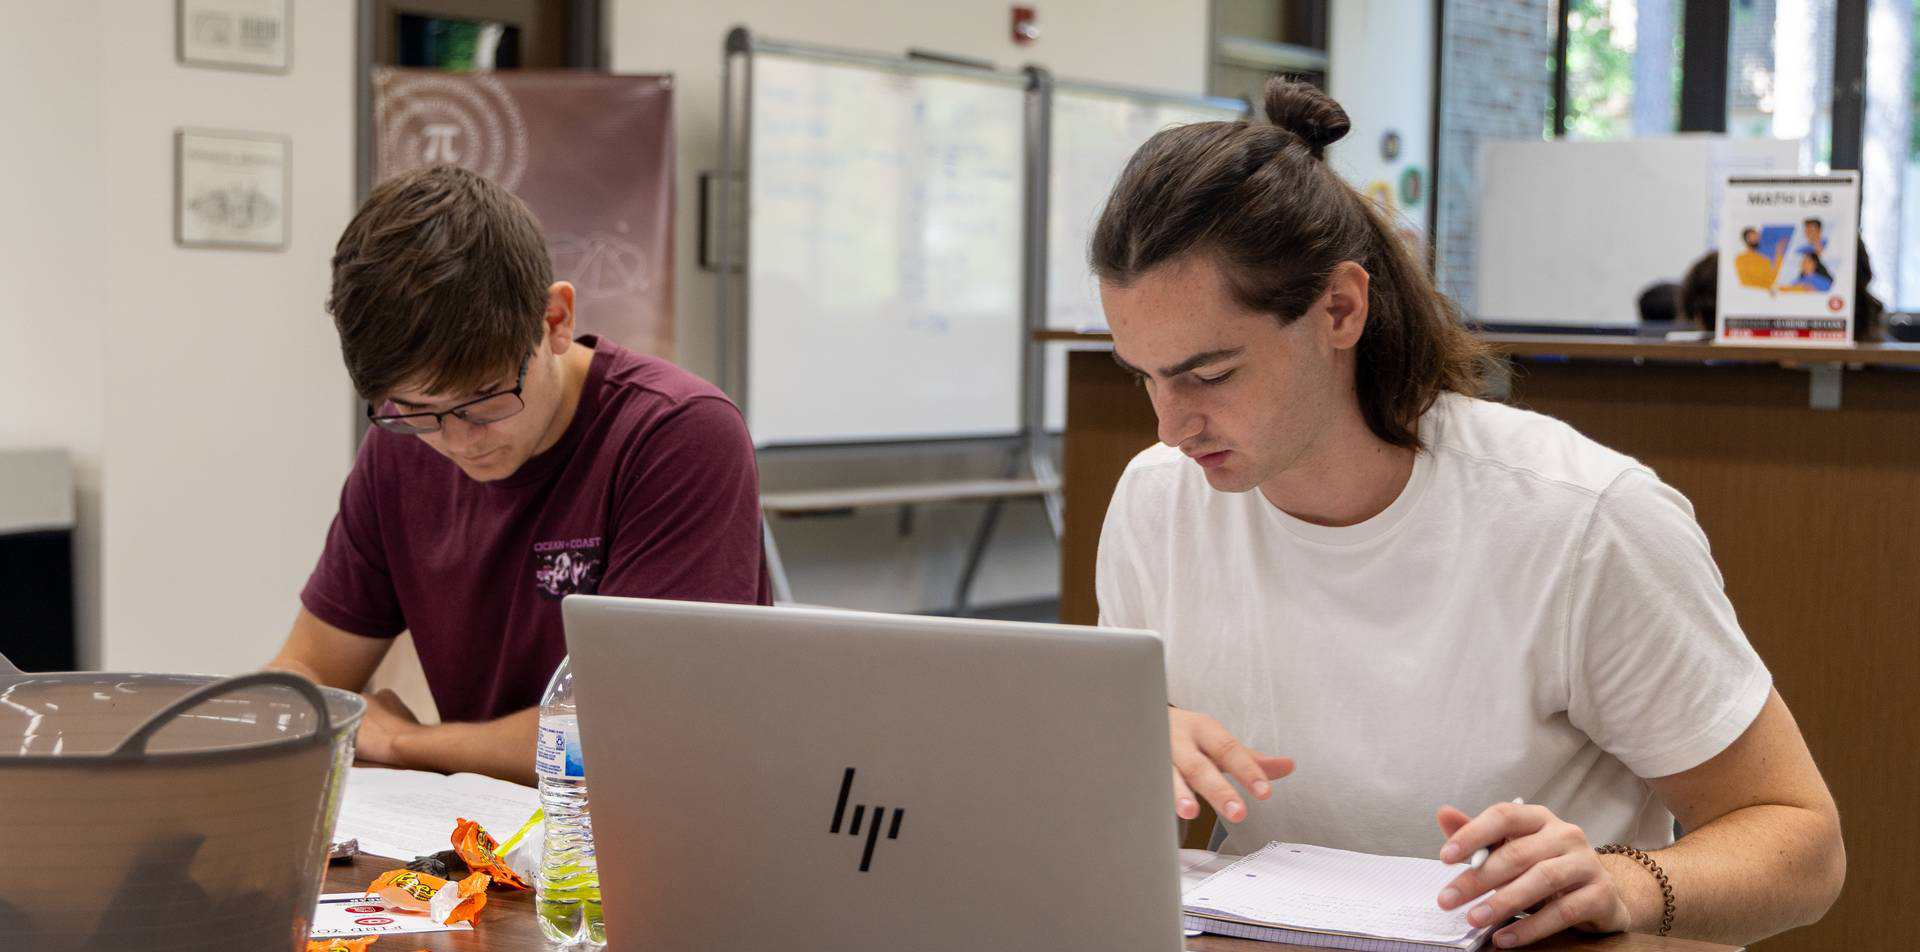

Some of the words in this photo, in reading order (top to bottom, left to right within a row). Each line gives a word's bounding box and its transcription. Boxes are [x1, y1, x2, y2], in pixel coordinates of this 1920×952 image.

[1747, 192, 1796, 207] MATH
[1799, 192, 1833, 207] LAB
[570, 537, 601, 548] COAST
